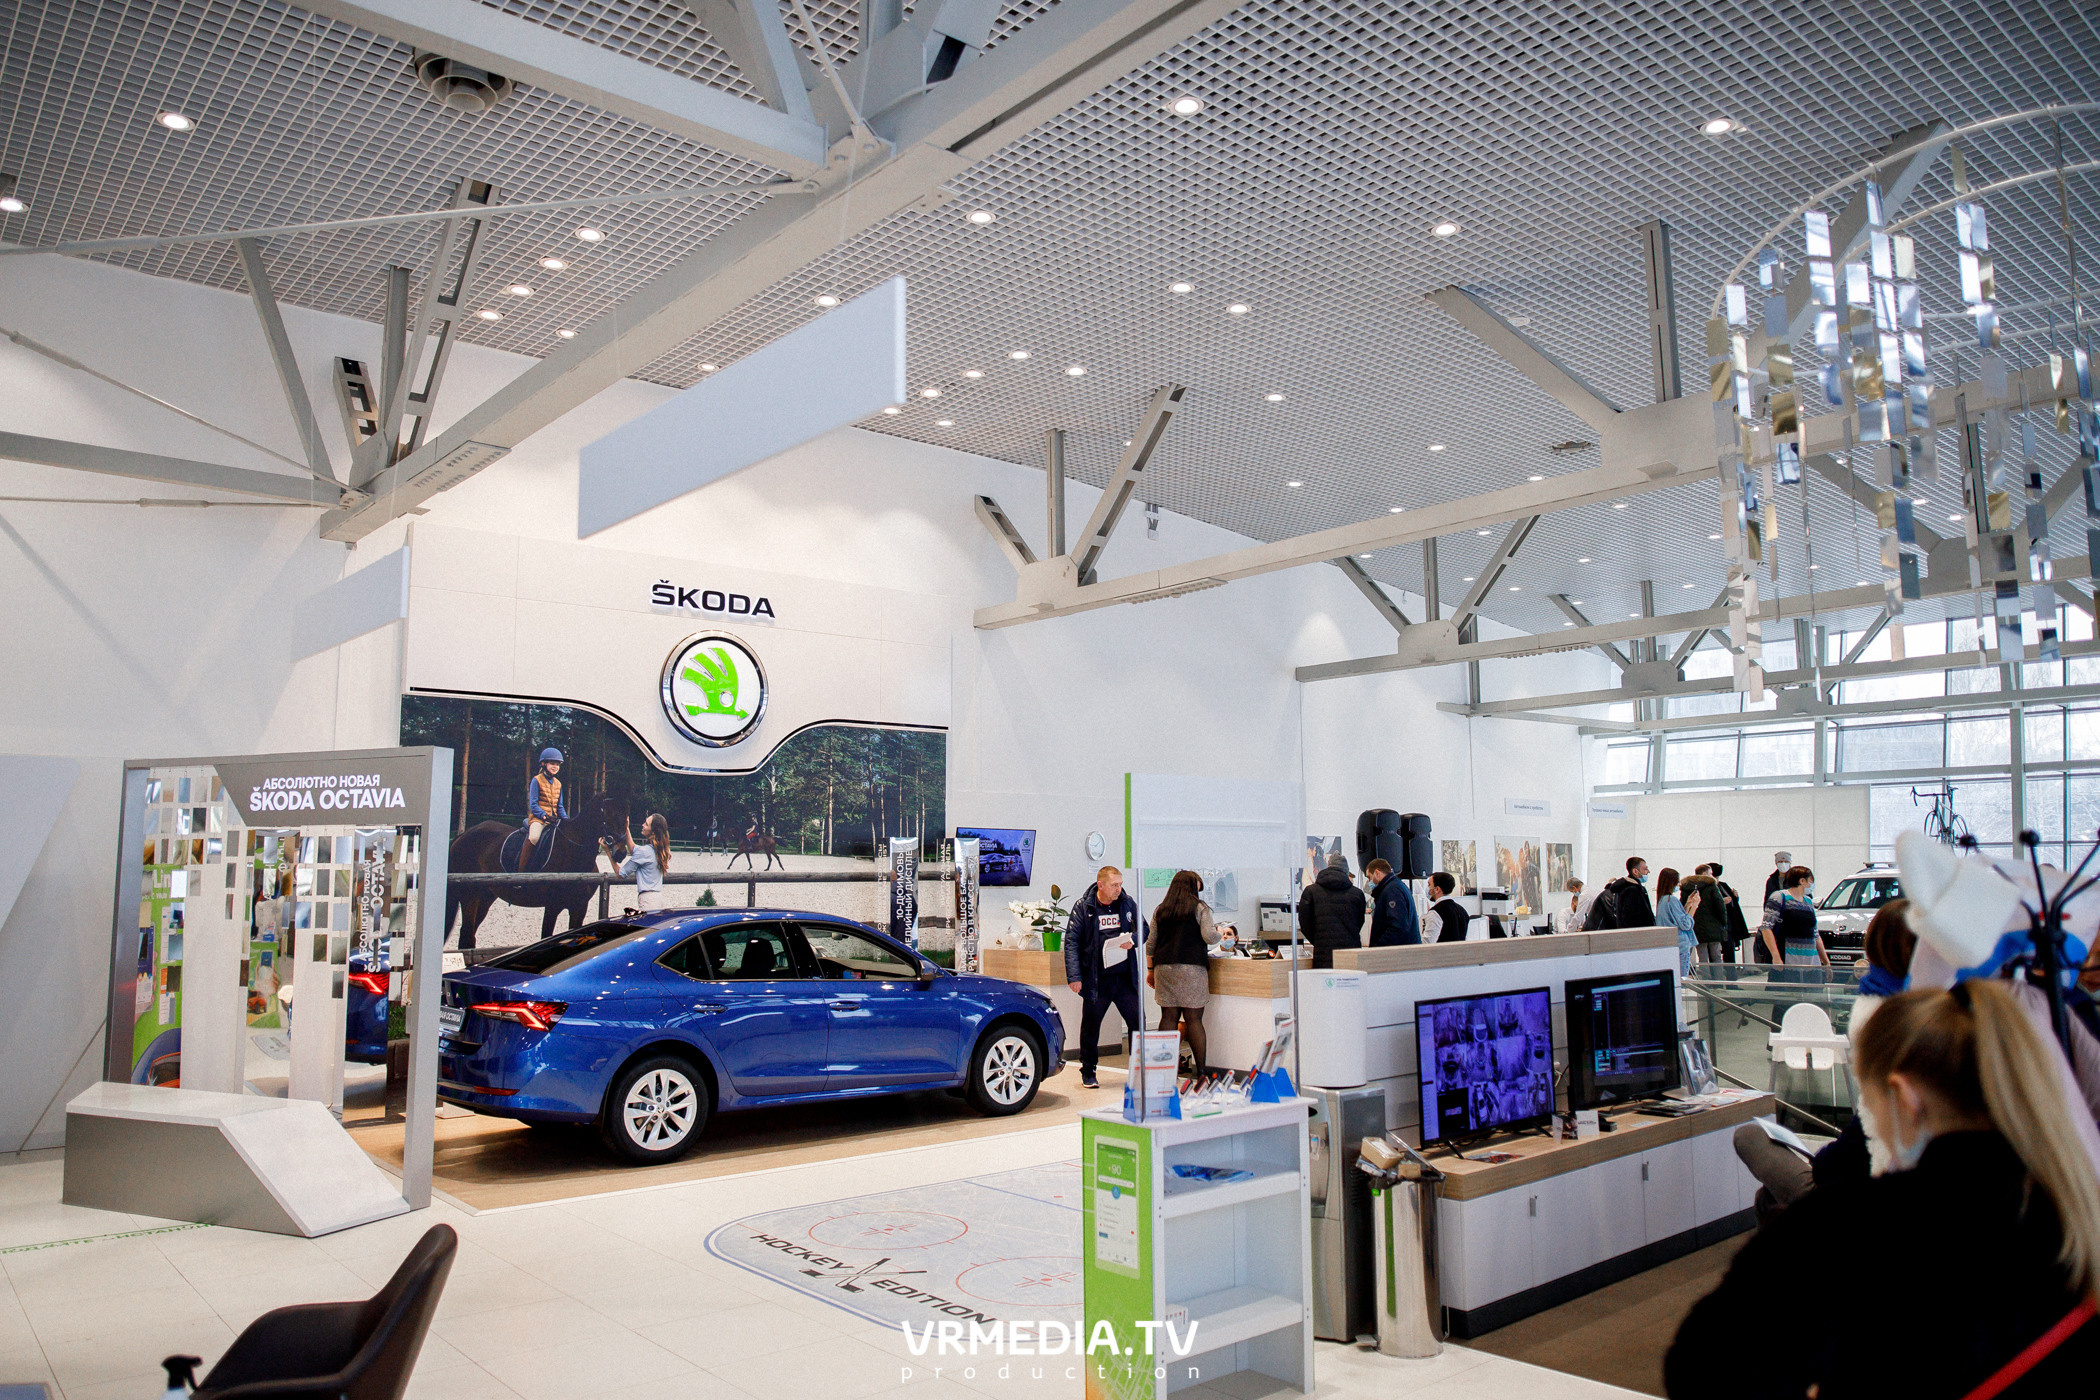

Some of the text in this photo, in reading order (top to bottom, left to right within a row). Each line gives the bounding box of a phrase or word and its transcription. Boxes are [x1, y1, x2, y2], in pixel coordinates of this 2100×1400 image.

[652, 579, 775, 618] ŠKODA
[250, 786, 405, 811] ŠKODA OCTAVIA
[263, 774, 380, 790] АБСОЛЮТНО НОВАЯ
[359, 859, 371, 961] АБСОЛЮТНО НОВАЯ
[903, 893, 912, 948] ЕДИЙНЫЙ
[750, 1234, 855, 1270] HOCKEY
[870, 1279, 997, 1325] EDITION
